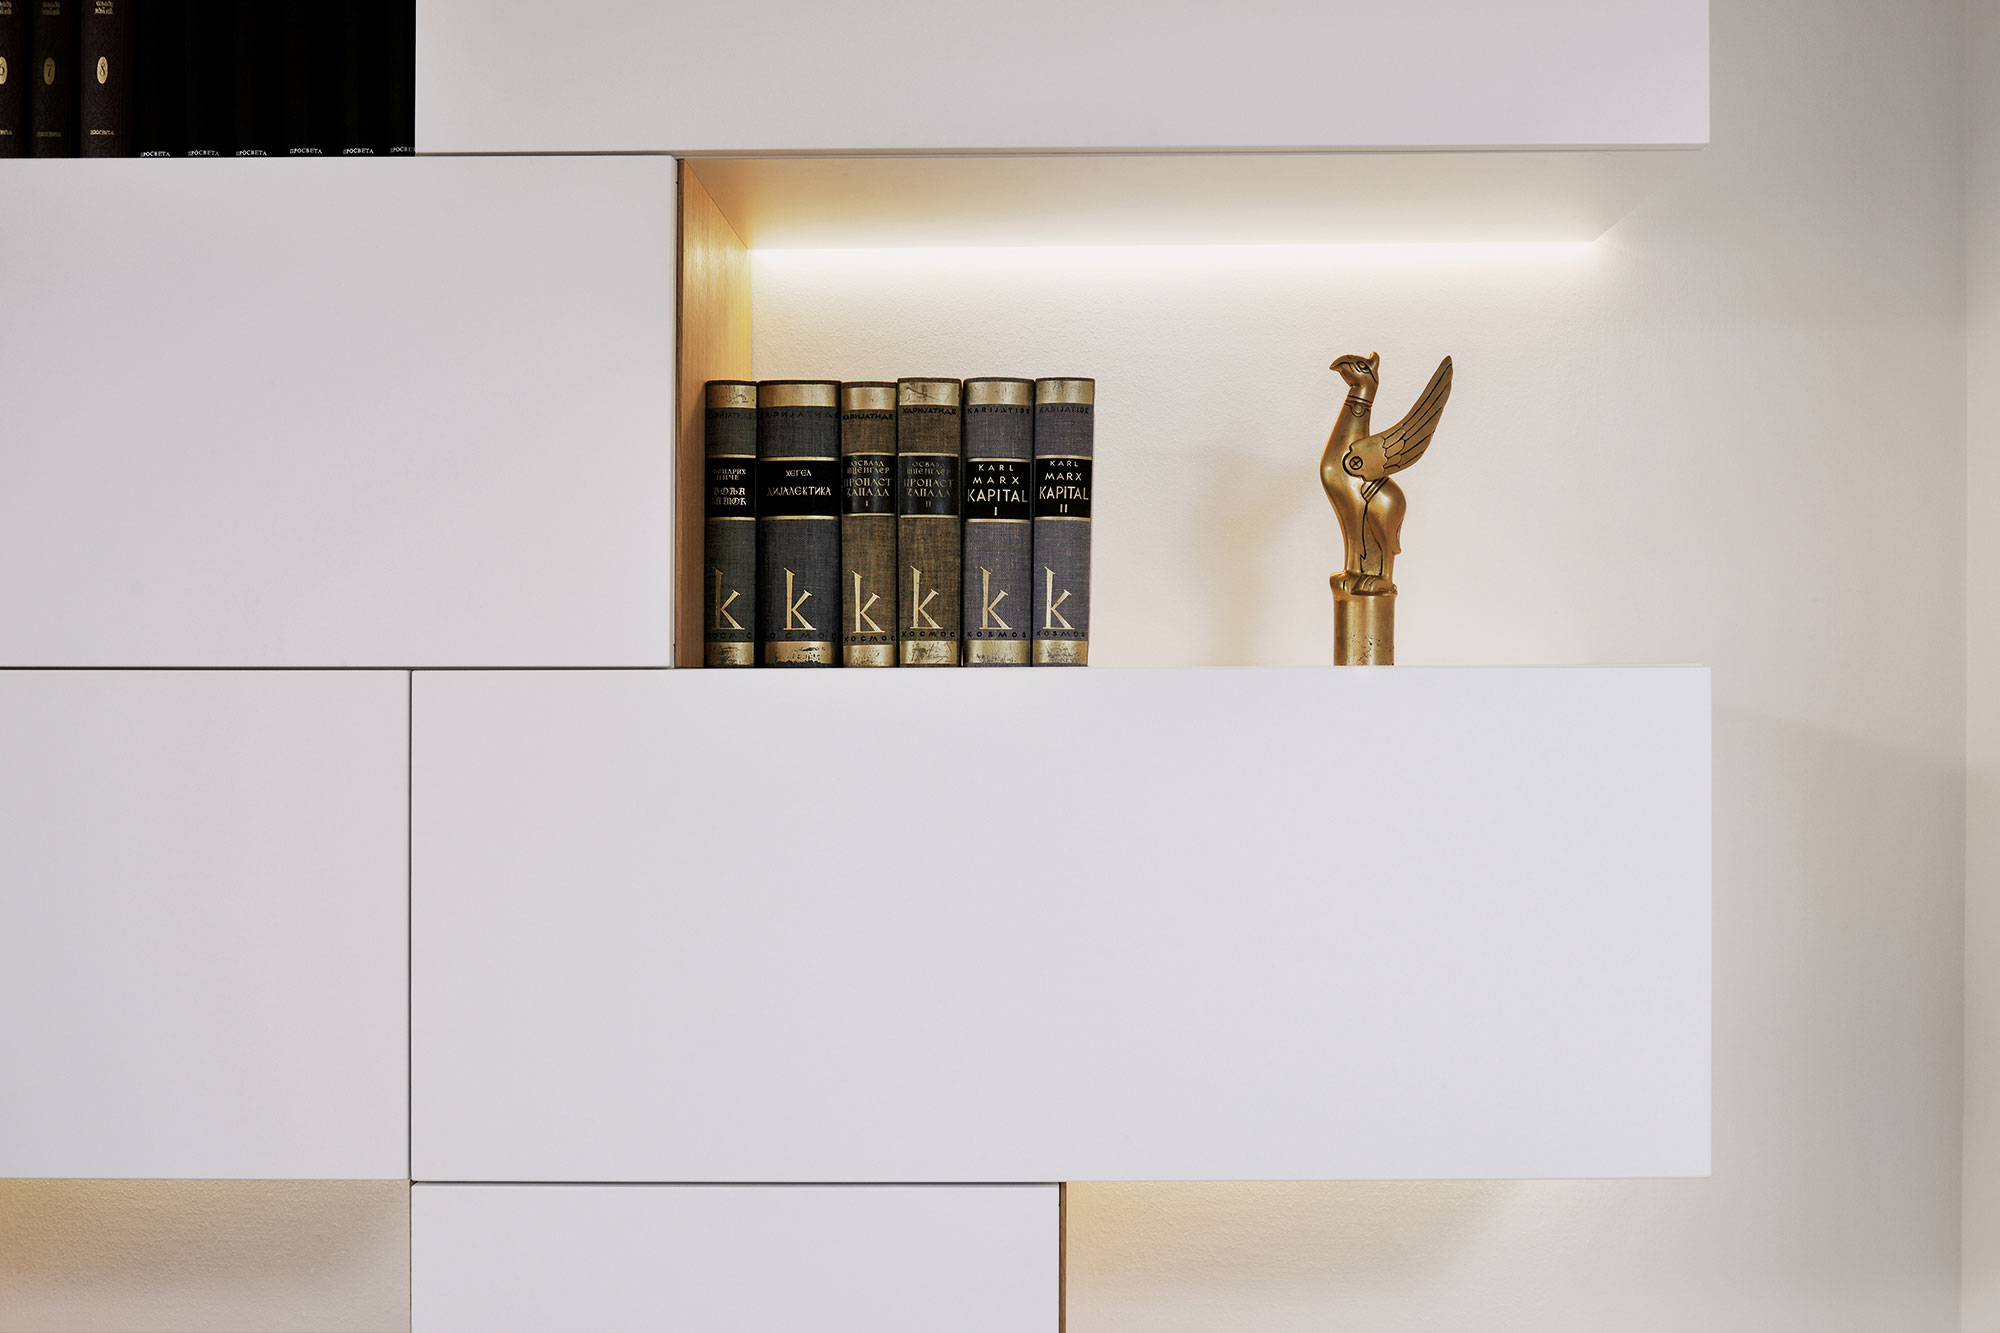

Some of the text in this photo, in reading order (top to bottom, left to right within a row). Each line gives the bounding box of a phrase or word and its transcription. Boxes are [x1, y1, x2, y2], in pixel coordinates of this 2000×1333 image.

[46, 63, 53, 78] 7
[99, 62, 106, 76] 8
[967, 407, 1031, 415] KARIJATIDE
[978, 464, 1014, 472] KARL
[1049, 460, 1079, 468] KARL
[786, 469, 812, 477] ХЕГЕЛ
[1044, 472, 1082, 481] MARX
[843, 477, 892, 488] ПРОПАСТ
[903, 478, 955, 488] ПРОПАСТ
[972, 475, 1020, 485] MARX
[766, 486, 832, 497] ДИЈАЛЕКТИКА
[967, 488, 1028, 503] KAPITAL
[1039, 485, 1089, 500] KAPITAL
[925, 500, 933, 508] II
[1060, 503, 1069, 513] II
[994, 506, 999, 516] I
[706, 632, 753, 640] ОСМОС
[967, 631, 1027, 639] KOSMOS
[1036, 630, 1085, 638] KOSMOS
